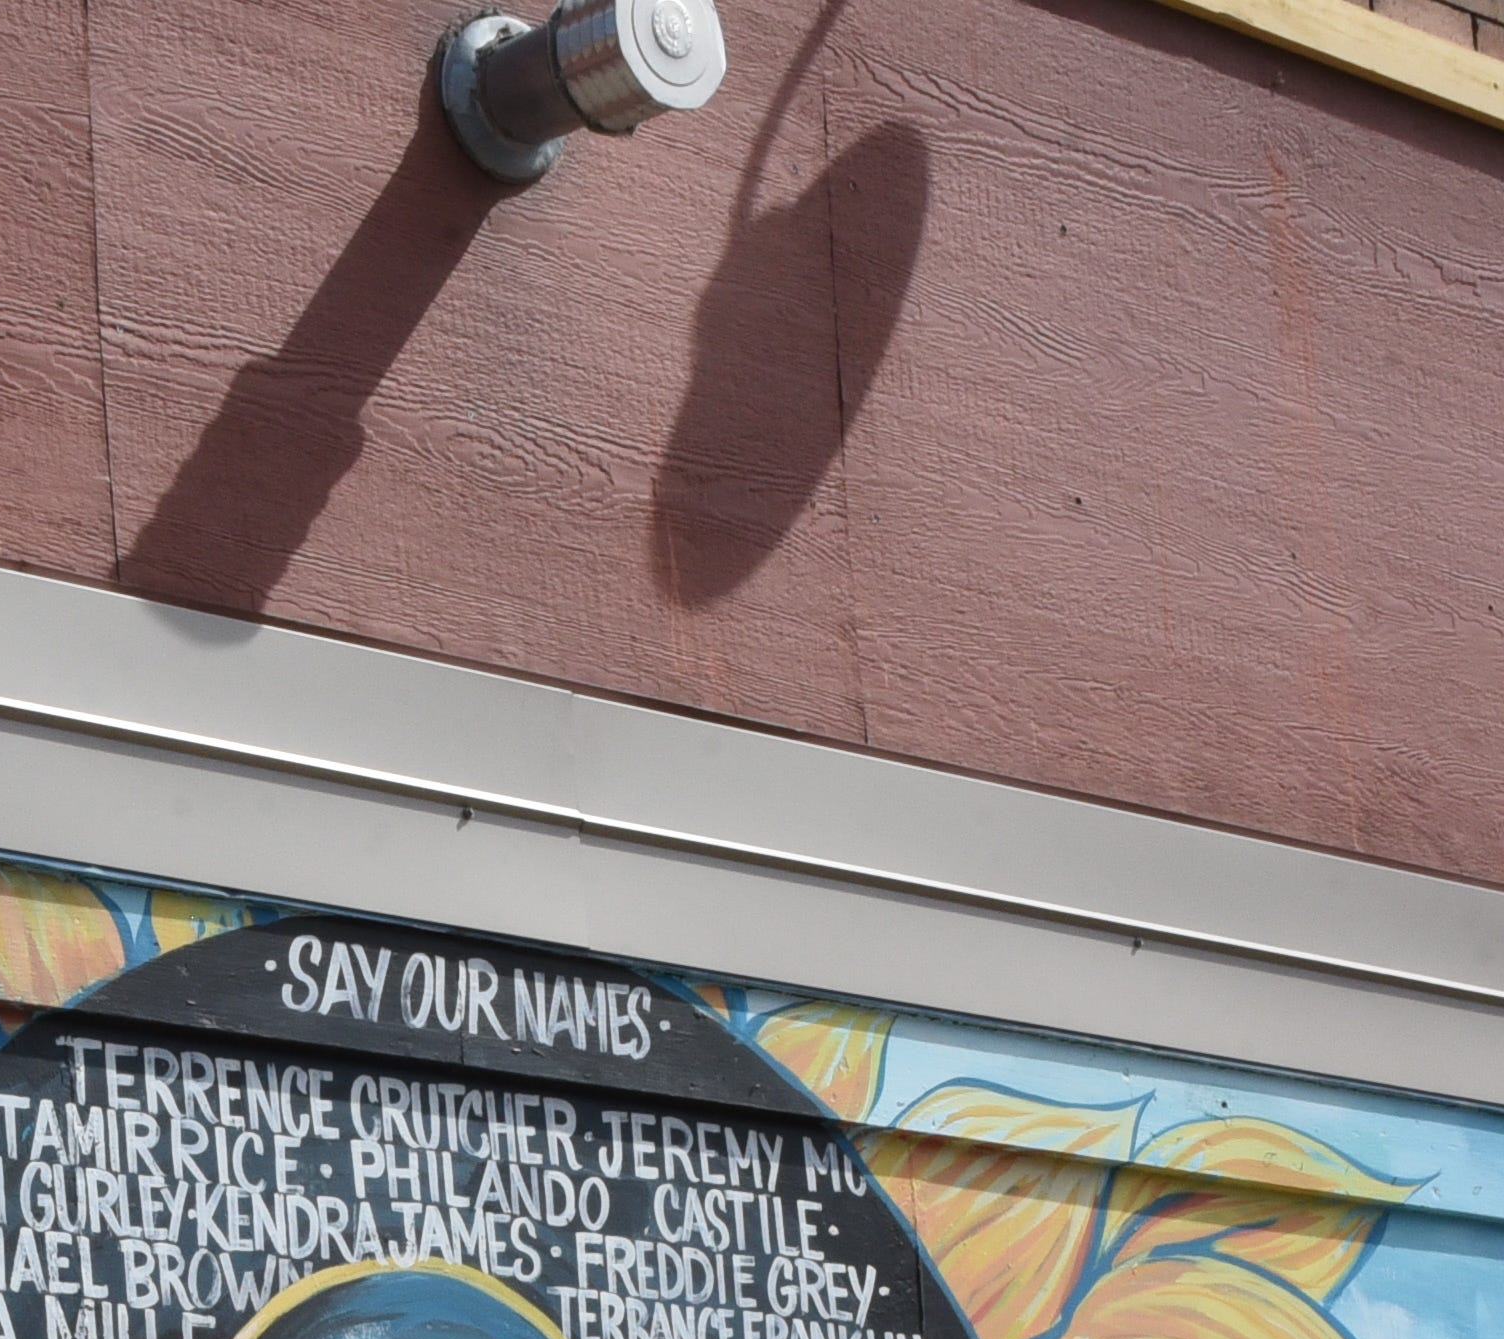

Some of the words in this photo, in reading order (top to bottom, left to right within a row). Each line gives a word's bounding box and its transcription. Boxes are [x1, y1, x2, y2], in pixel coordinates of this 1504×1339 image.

[282, 934, 391, 1023] SAY
[401, 952, 512, 1041] OUR
[514, 968, 652, 1060] NAMES
[60, 1036, 340, 1140] TERRENCE
[349, 1074, 584, 1171] CRUTCHER
[598, 1110, 783, 1192] JEREMY
[19, 1161, 188, 1243] GURLEY
[194, 1182, 390, 1266] KENDRA
[389, 1202, 541, 1283] JAMES
[576, 1232, 758, 1308] FREDDIE
[767, 1256, 877, 1329] GREY
[170, 1118, 304, 1195] RICE
[350, 1139, 610, 1231] PHILANDO
[653, 1183, 825, 1260] CASTILE
